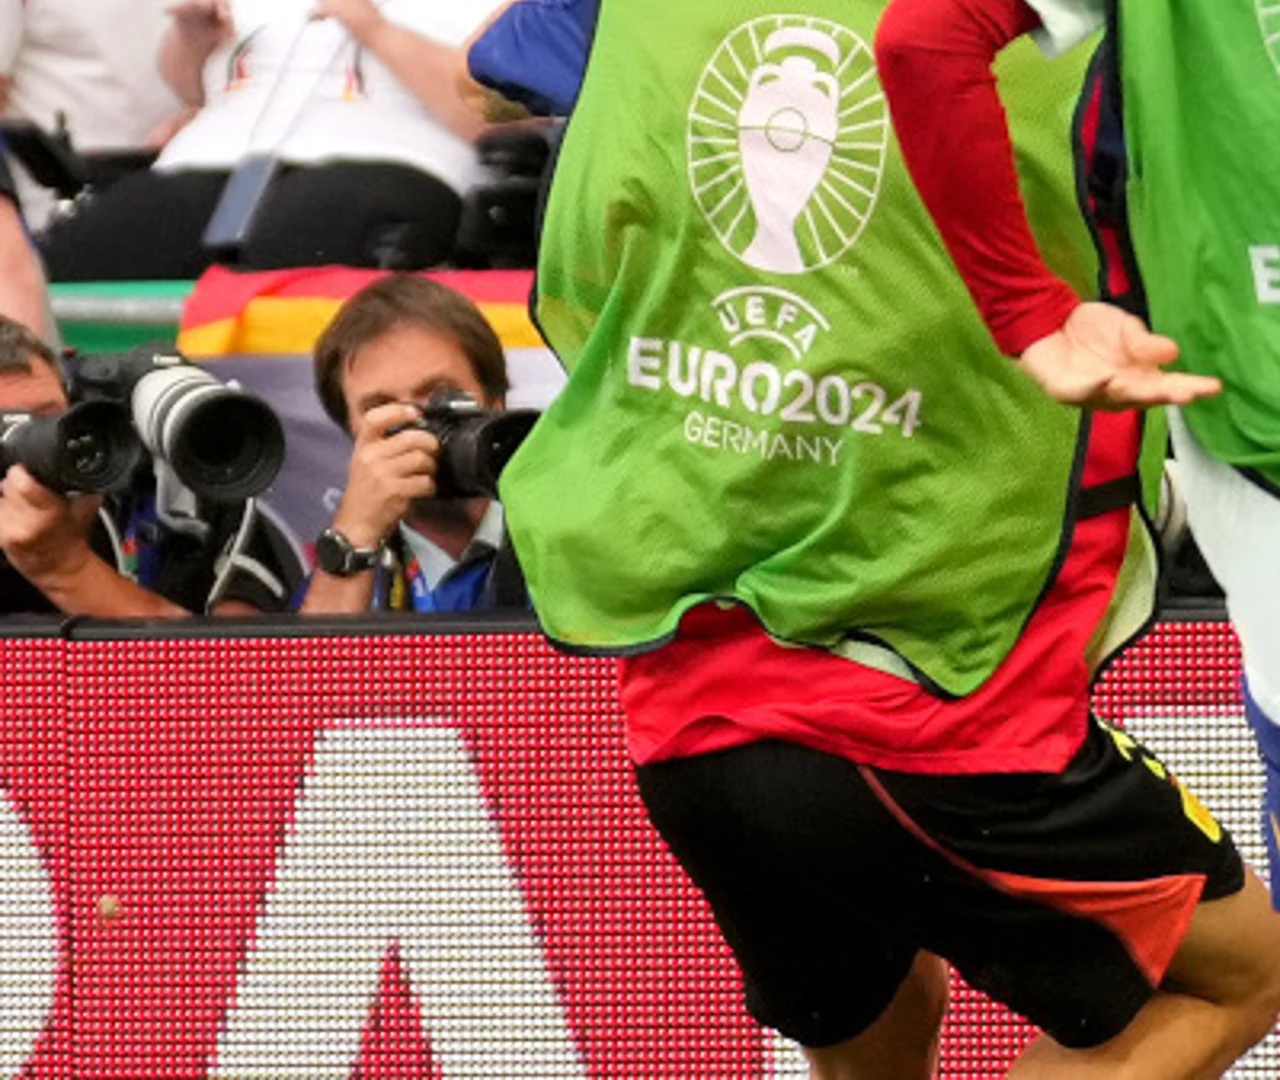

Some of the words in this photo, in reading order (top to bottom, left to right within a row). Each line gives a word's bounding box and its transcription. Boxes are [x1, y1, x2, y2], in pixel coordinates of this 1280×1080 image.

[718, 295, 818, 353] UEFA
[628, 336, 922, 437] EURO2024
[683, 411, 843, 466] GERMANY
